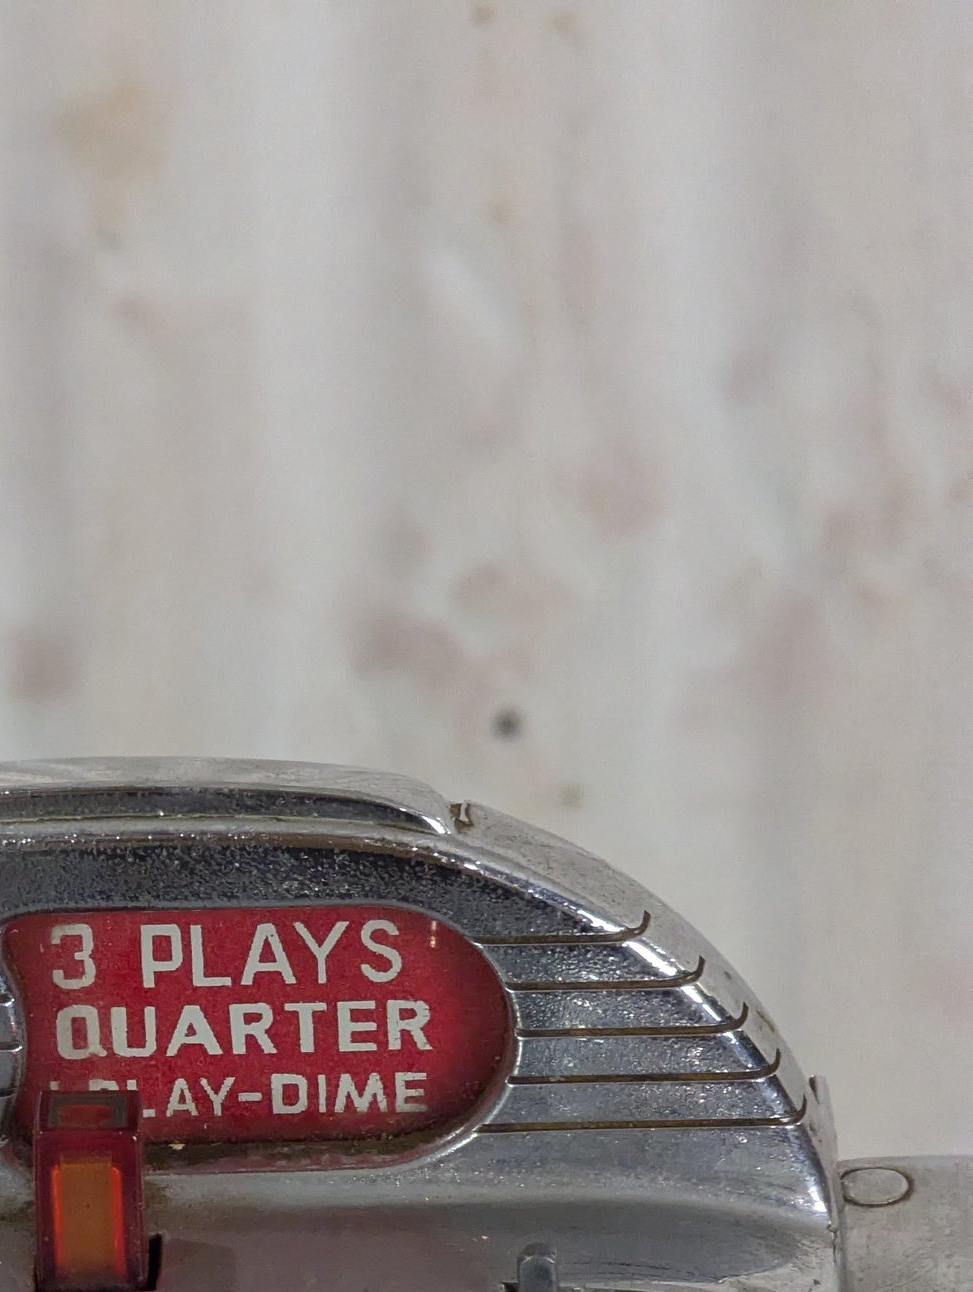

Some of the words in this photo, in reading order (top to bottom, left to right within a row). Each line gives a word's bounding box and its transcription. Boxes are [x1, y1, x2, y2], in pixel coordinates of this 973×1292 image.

[51, 923, 95, 989] 3
[140, 919, 402, 988] PLAYS
[55, 1000, 433, 1060] QUARTER
[88, 1072, 427, 1118] AY-DIME
